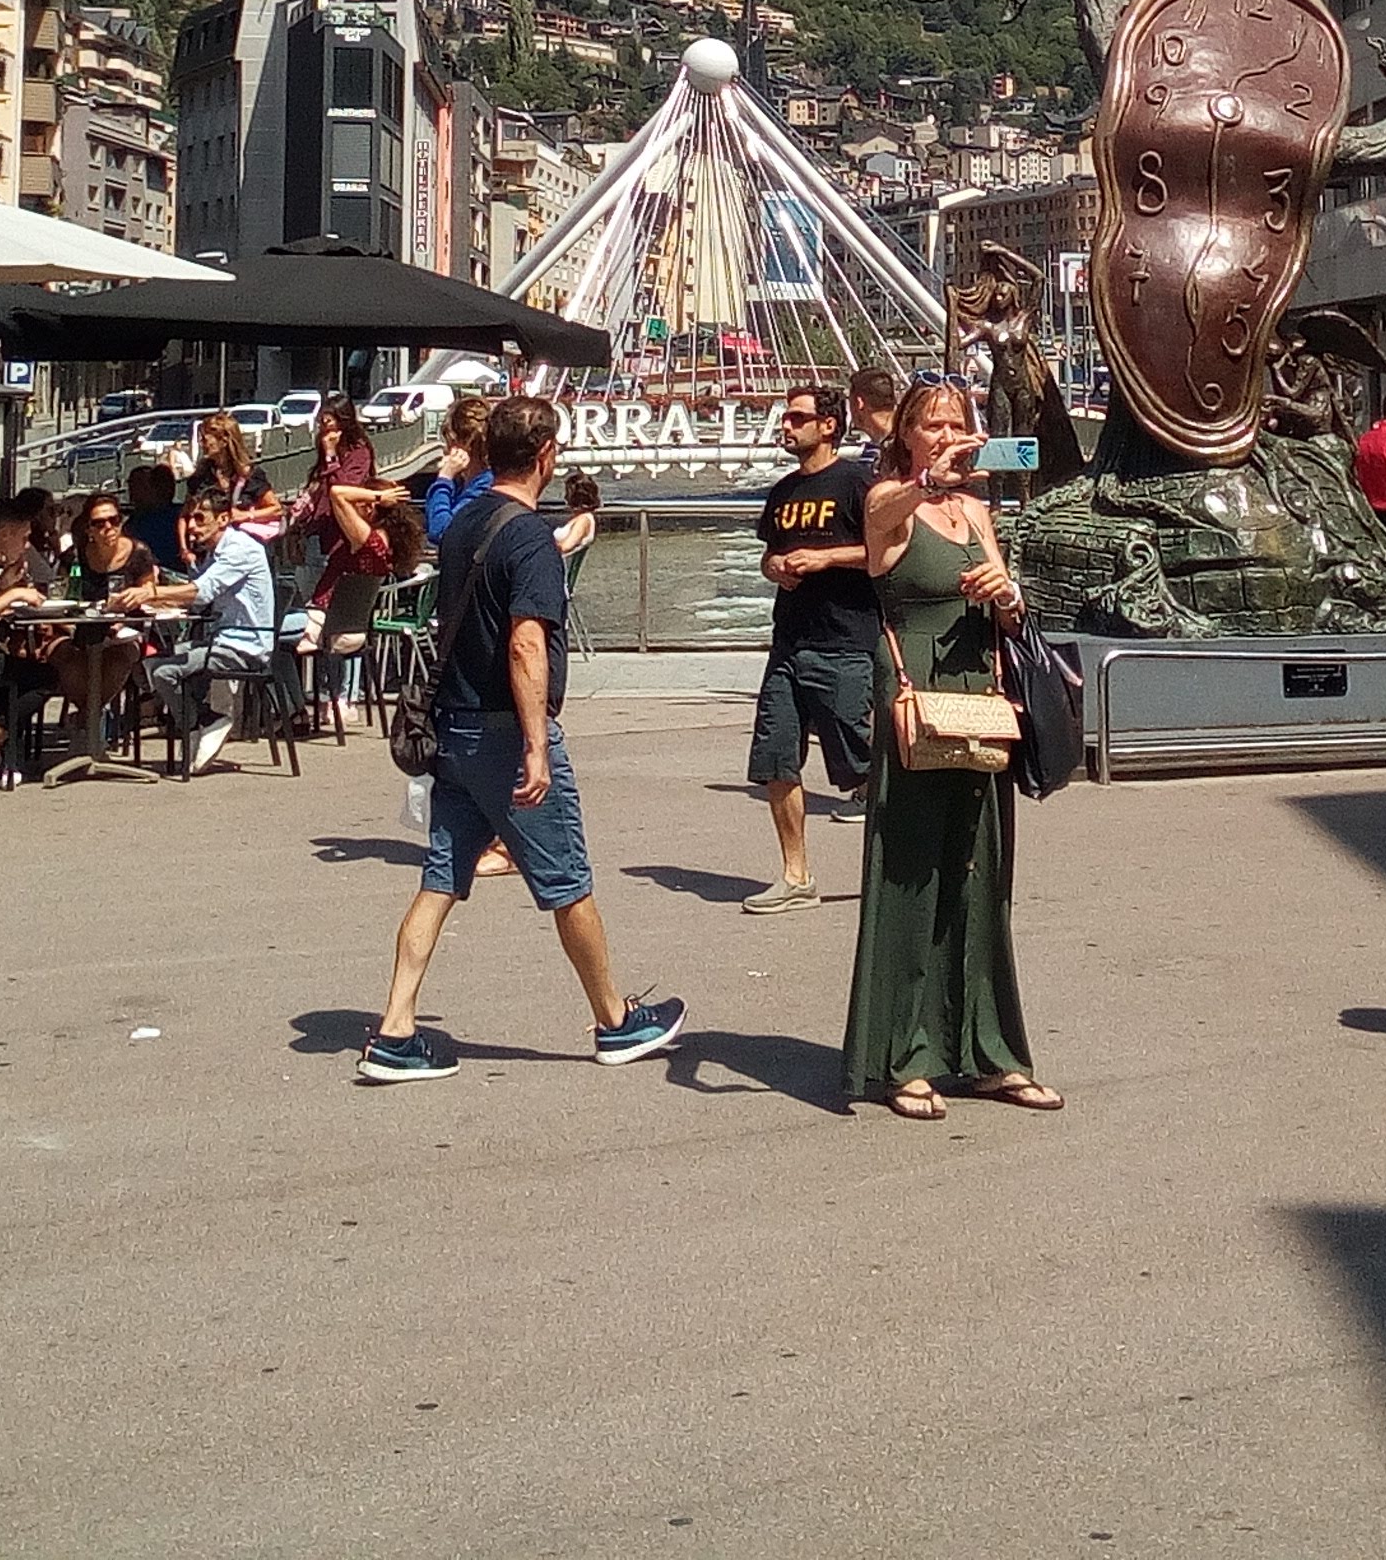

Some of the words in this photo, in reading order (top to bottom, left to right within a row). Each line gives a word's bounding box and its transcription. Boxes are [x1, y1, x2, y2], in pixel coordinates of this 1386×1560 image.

[1150, 33, 1187, 68] 10
[1145, 82, 1172, 128] 9
[1284, 83, 1312, 121] 2
[1137, 150, 1168, 214] 8
[1263, 168, 1293, 232] 3
[1124, 242, 1152, 307] 7
[1221, 300, 1252, 358] 5
[9, 361, 29, 382] P
